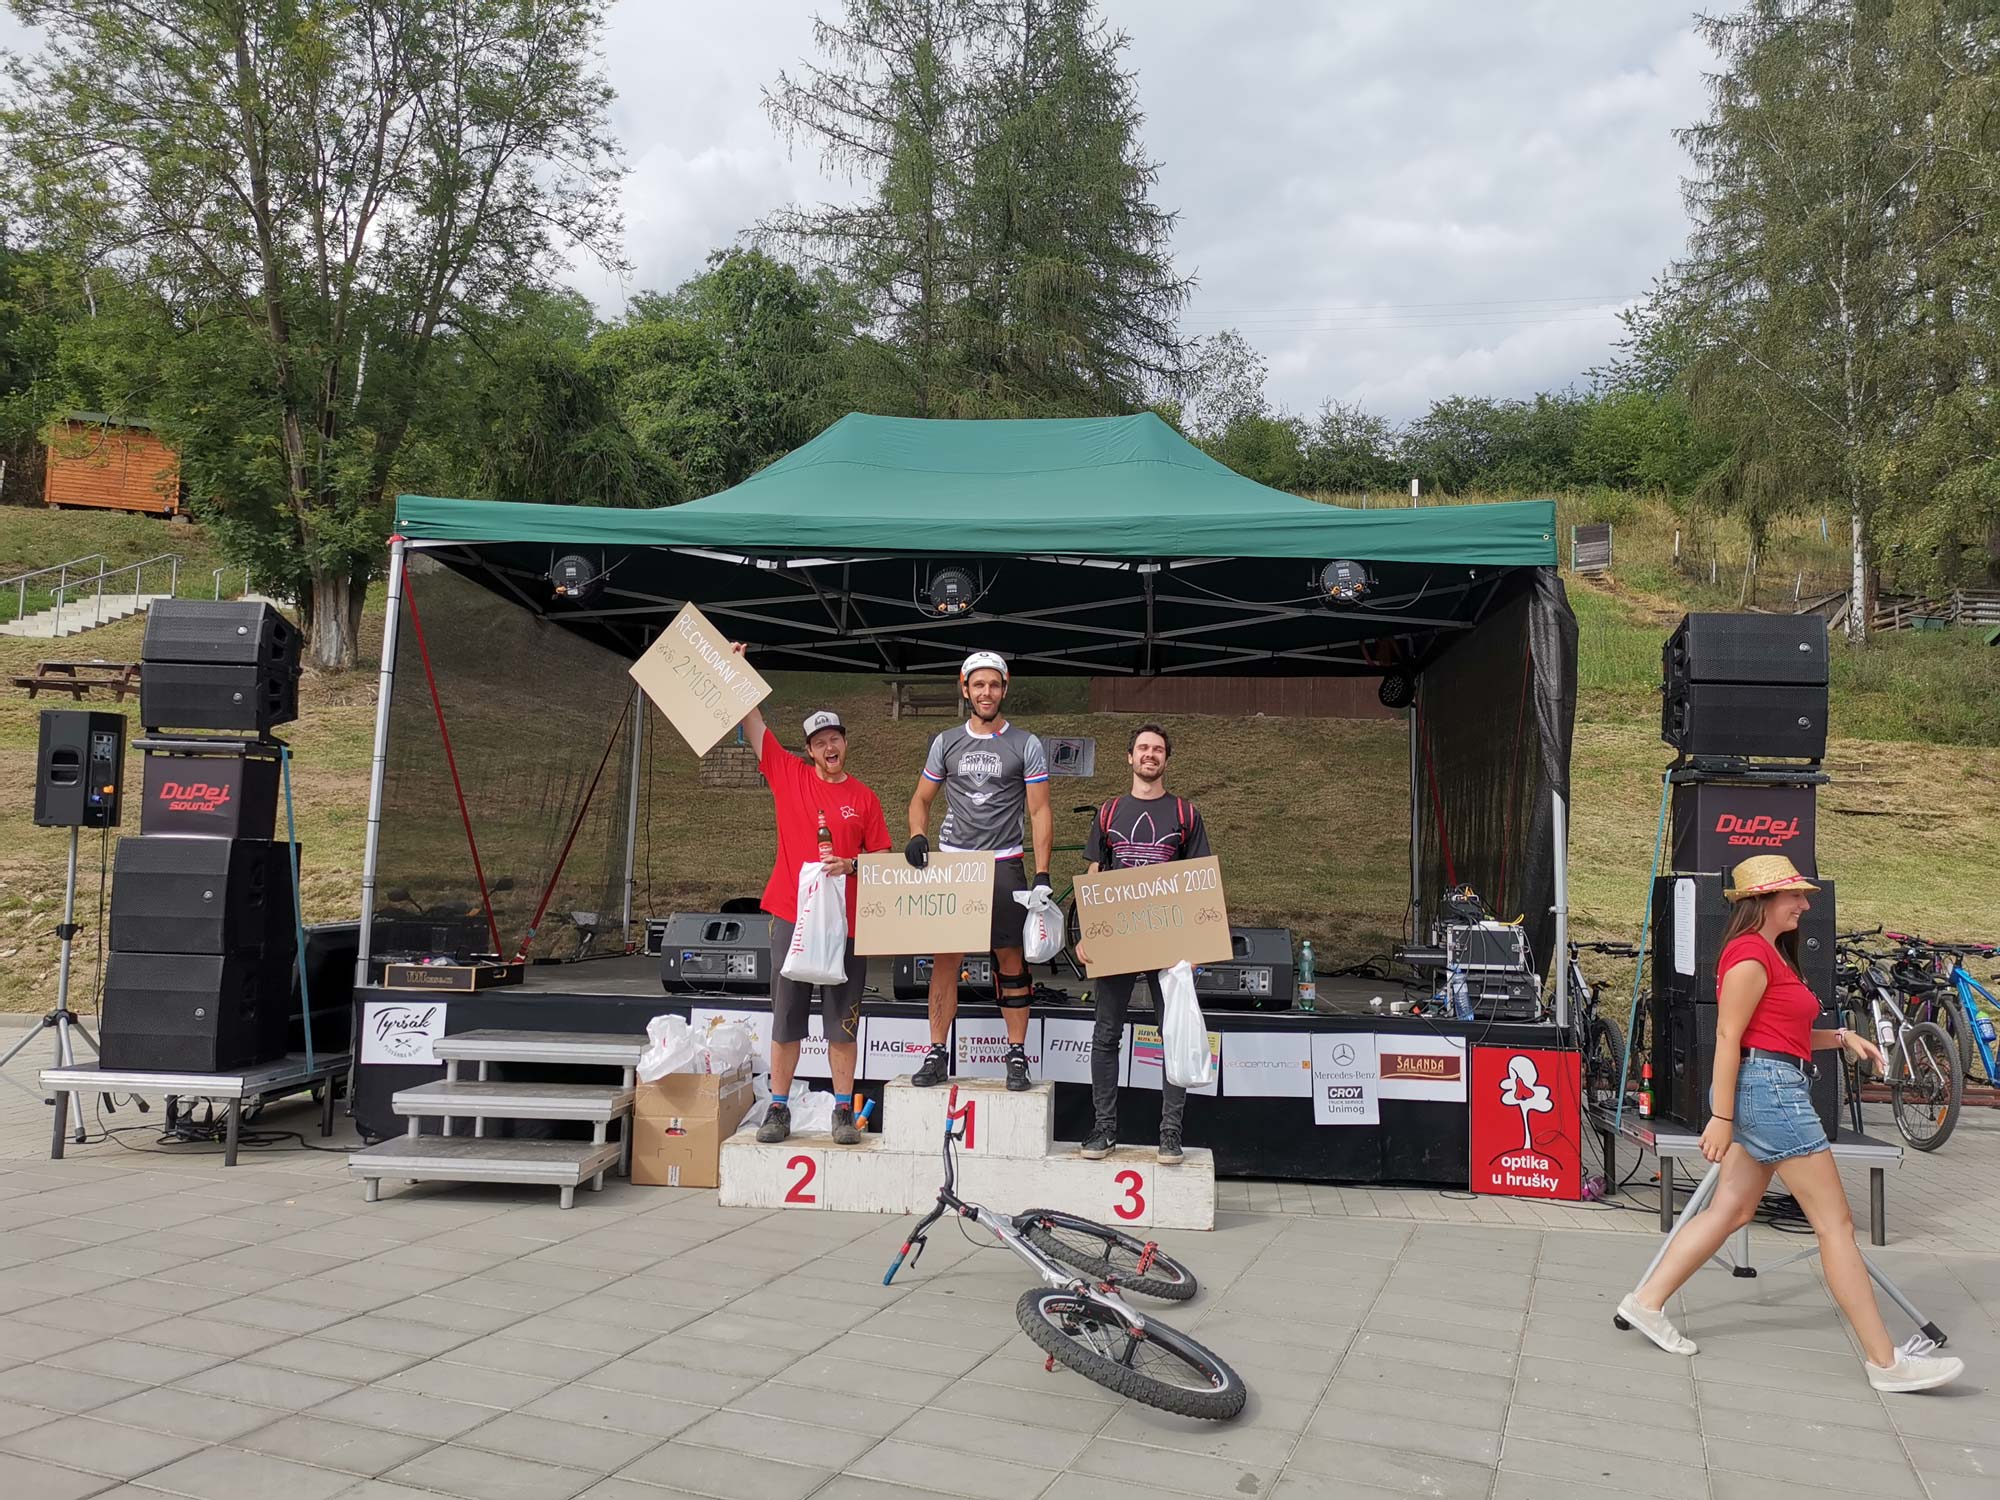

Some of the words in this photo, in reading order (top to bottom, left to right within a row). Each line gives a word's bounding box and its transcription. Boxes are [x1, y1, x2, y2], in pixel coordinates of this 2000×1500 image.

[675, 613, 740, 684] RECYKLOVÁNÍ
[732, 676, 761, 706] 2020
[672, 655, 691, 674] 2
[685, 664, 722, 709] MÍSTO
[160, 782, 230, 805] DuPej
[169, 801, 215, 811] sound
[1715, 814, 1800, 840] DuPej
[1728, 835, 1783, 847] sound
[862, 864, 954, 885] RECYKLOVÁNÍ
[955, 861, 987, 883] 2020
[1081, 873, 1180, 906] RECYKLOVÁNÍ
[1183, 867, 1217, 893] 2020
[894, 895, 903, 916] 1
[908, 891, 957, 917] MÍSTO
[373, 1006, 437, 1042] Tyršák
[904, 1042, 932, 1054] SPO
[970, 1035, 1009, 1045] TRADIČ
[1050, 1039, 1092, 1053] FITNE
[970, 1056, 977, 1064] V
[980, 1055, 1039, 1064] RAKOKU
[1075, 1053, 1090, 1064] ZO
[1396, 1055, 1444, 1070] ŠALANDA
[1314, 1071, 1376, 1080] Mercedes-Benz
[1329, 1087, 1362, 1098] CROY
[1328, 1105, 1365, 1115] Unimog
[951, 1100, 976, 1149] 1
[1501, 1155, 1549, 1171] optika
[784, 1155, 816, 1204] 2
[1491, 1174, 1502, 1185] u
[1506, 1173, 1560, 1192] hrušky
[1113, 1170, 1146, 1220] 3
